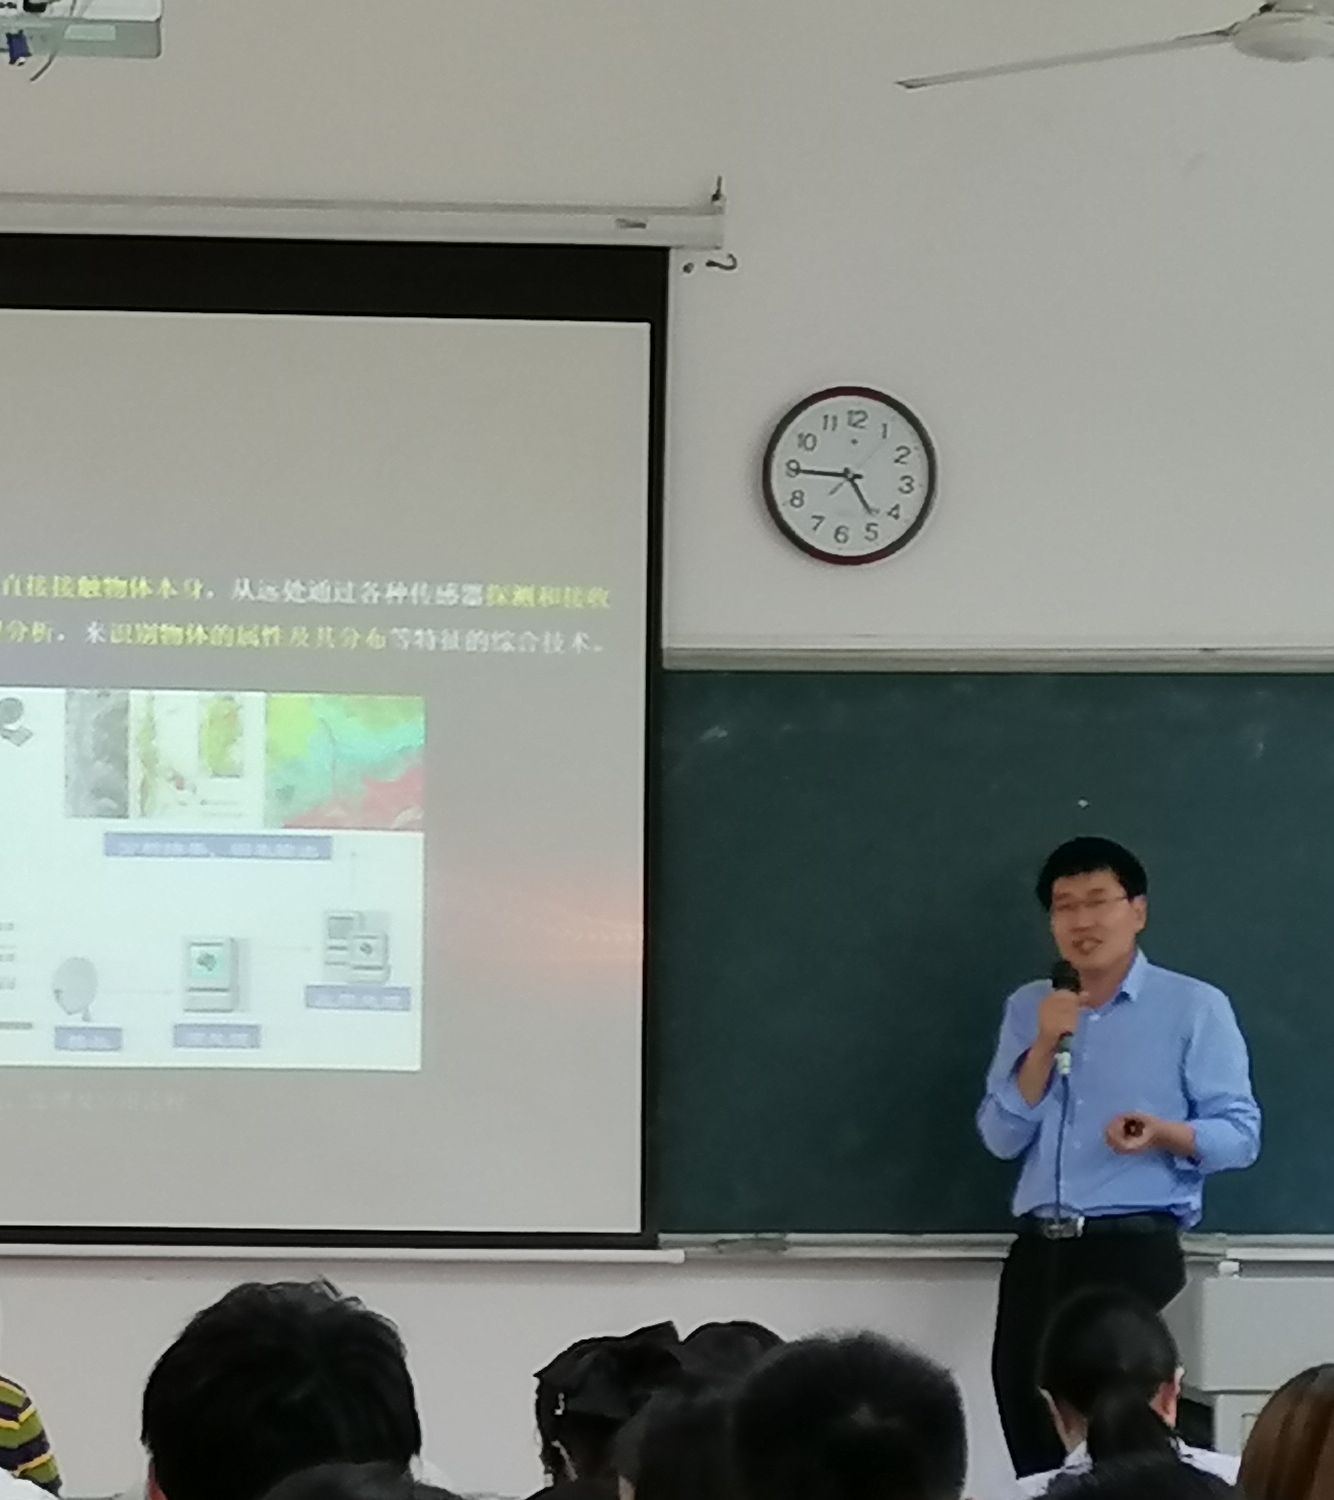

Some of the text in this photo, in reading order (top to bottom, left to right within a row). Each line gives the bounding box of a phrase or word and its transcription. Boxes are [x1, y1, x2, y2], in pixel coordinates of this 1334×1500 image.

[823, 414, 838, 431] 11
[847, 410, 868, 428] 12
[881, 423, 888, 439] 1
[797, 432, 817, 451] 10
[894, 445, 912, 464] 2
[785, 459, 800, 478] 9
[898, 475, 915, 494] 3
[790, 489, 805, 508] 8
[887, 503, 901, 520] 4
[811, 515, 825, 531] 7
[864, 523, 879, 541] 5
[833, 525, 850, 544] 6
